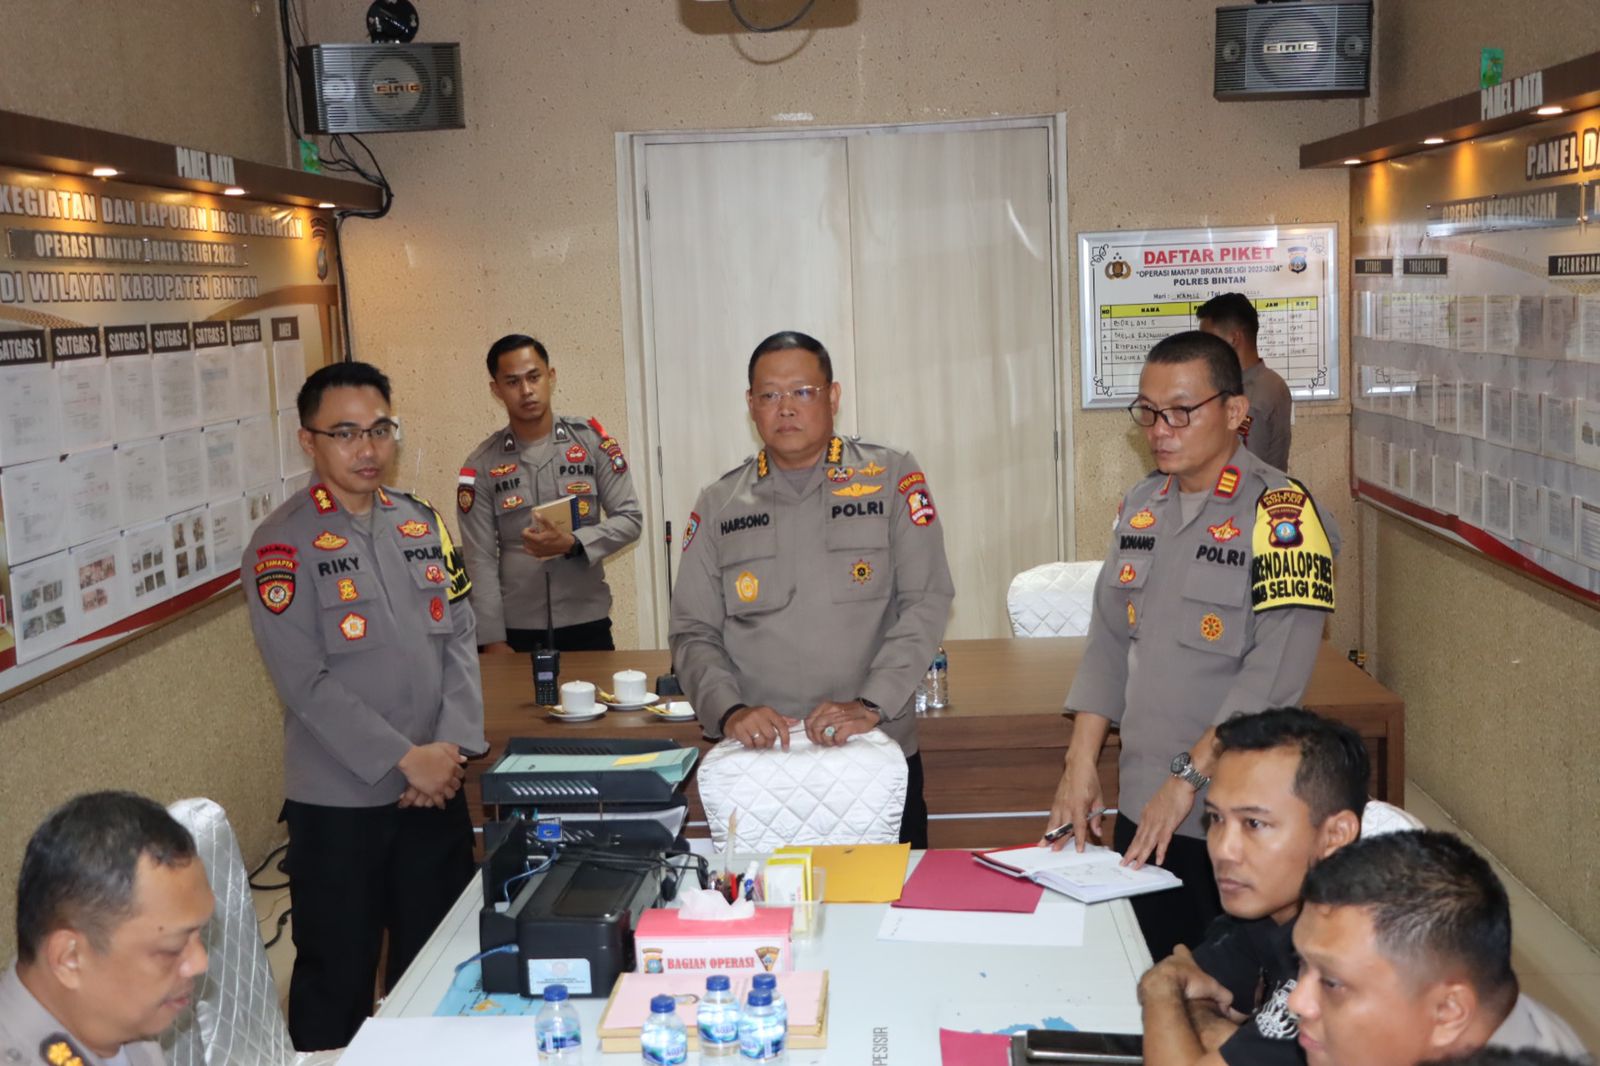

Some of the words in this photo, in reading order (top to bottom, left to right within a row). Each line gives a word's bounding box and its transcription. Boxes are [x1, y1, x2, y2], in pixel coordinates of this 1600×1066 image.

[1481, 81, 1512, 121] PANEL
[1514, 70, 1543, 112] DATA
[176, 146, 209, 180] PANEL
[1526, 134, 1579, 179] PANEL
[0, 184, 97, 222] KEGIATAN
[102, 196, 136, 224] DAN
[140, 203, 208, 231] LAPORAN
[211, 209, 248, 234] HASIL
[251, 216, 303, 239] KEGIATAN
[1442, 201, 1485, 227] OPERASI
[34, 233, 93, 258] OPERASI
[94, 236, 142, 260] MANTAP
[182, 244, 213, 263] SELIGI
[1143, 247, 1216, 265] DAFTAR
[1219, 246, 1274, 261] PIKET
[0, 272, 24, 302] DI
[28, 273, 116, 301] WILAYAH
[120, 273, 209, 301] KABUPATEN
[212, 275, 258, 300] BINTAN
[1173, 278, 1209, 286] POLRES
[1211, 276, 1246, 285] BINTAN
[108, 333, 139, 352] SATGAS
[140, 332, 146, 350] 3
[154, 330, 182, 348] SATGAS
[182, 329, 188, 345] 4
[195, 328, 219, 344] SATGAS
[220, 327, 225, 343] 5
[232, 326, 254, 342] SATGAS
[35, 337, 42, 358] 1
[56, 335, 90, 356] SATGAS
[90, 334, 97, 353] 2
[495, 478, 521, 493] ARIF
[831, 501, 884, 519] POLRI
[720, 513, 770, 535] HARSONO
[1196, 545, 1246, 567] POLRI
[317, 557, 360, 577] RIKY
[1269, 580, 1309, 599] SELIGI
[667, 958, 706, 969] BAGIAN
[710, 957, 755, 968] OPERASI
[872, 1026, 888, 1066] PESISIR
